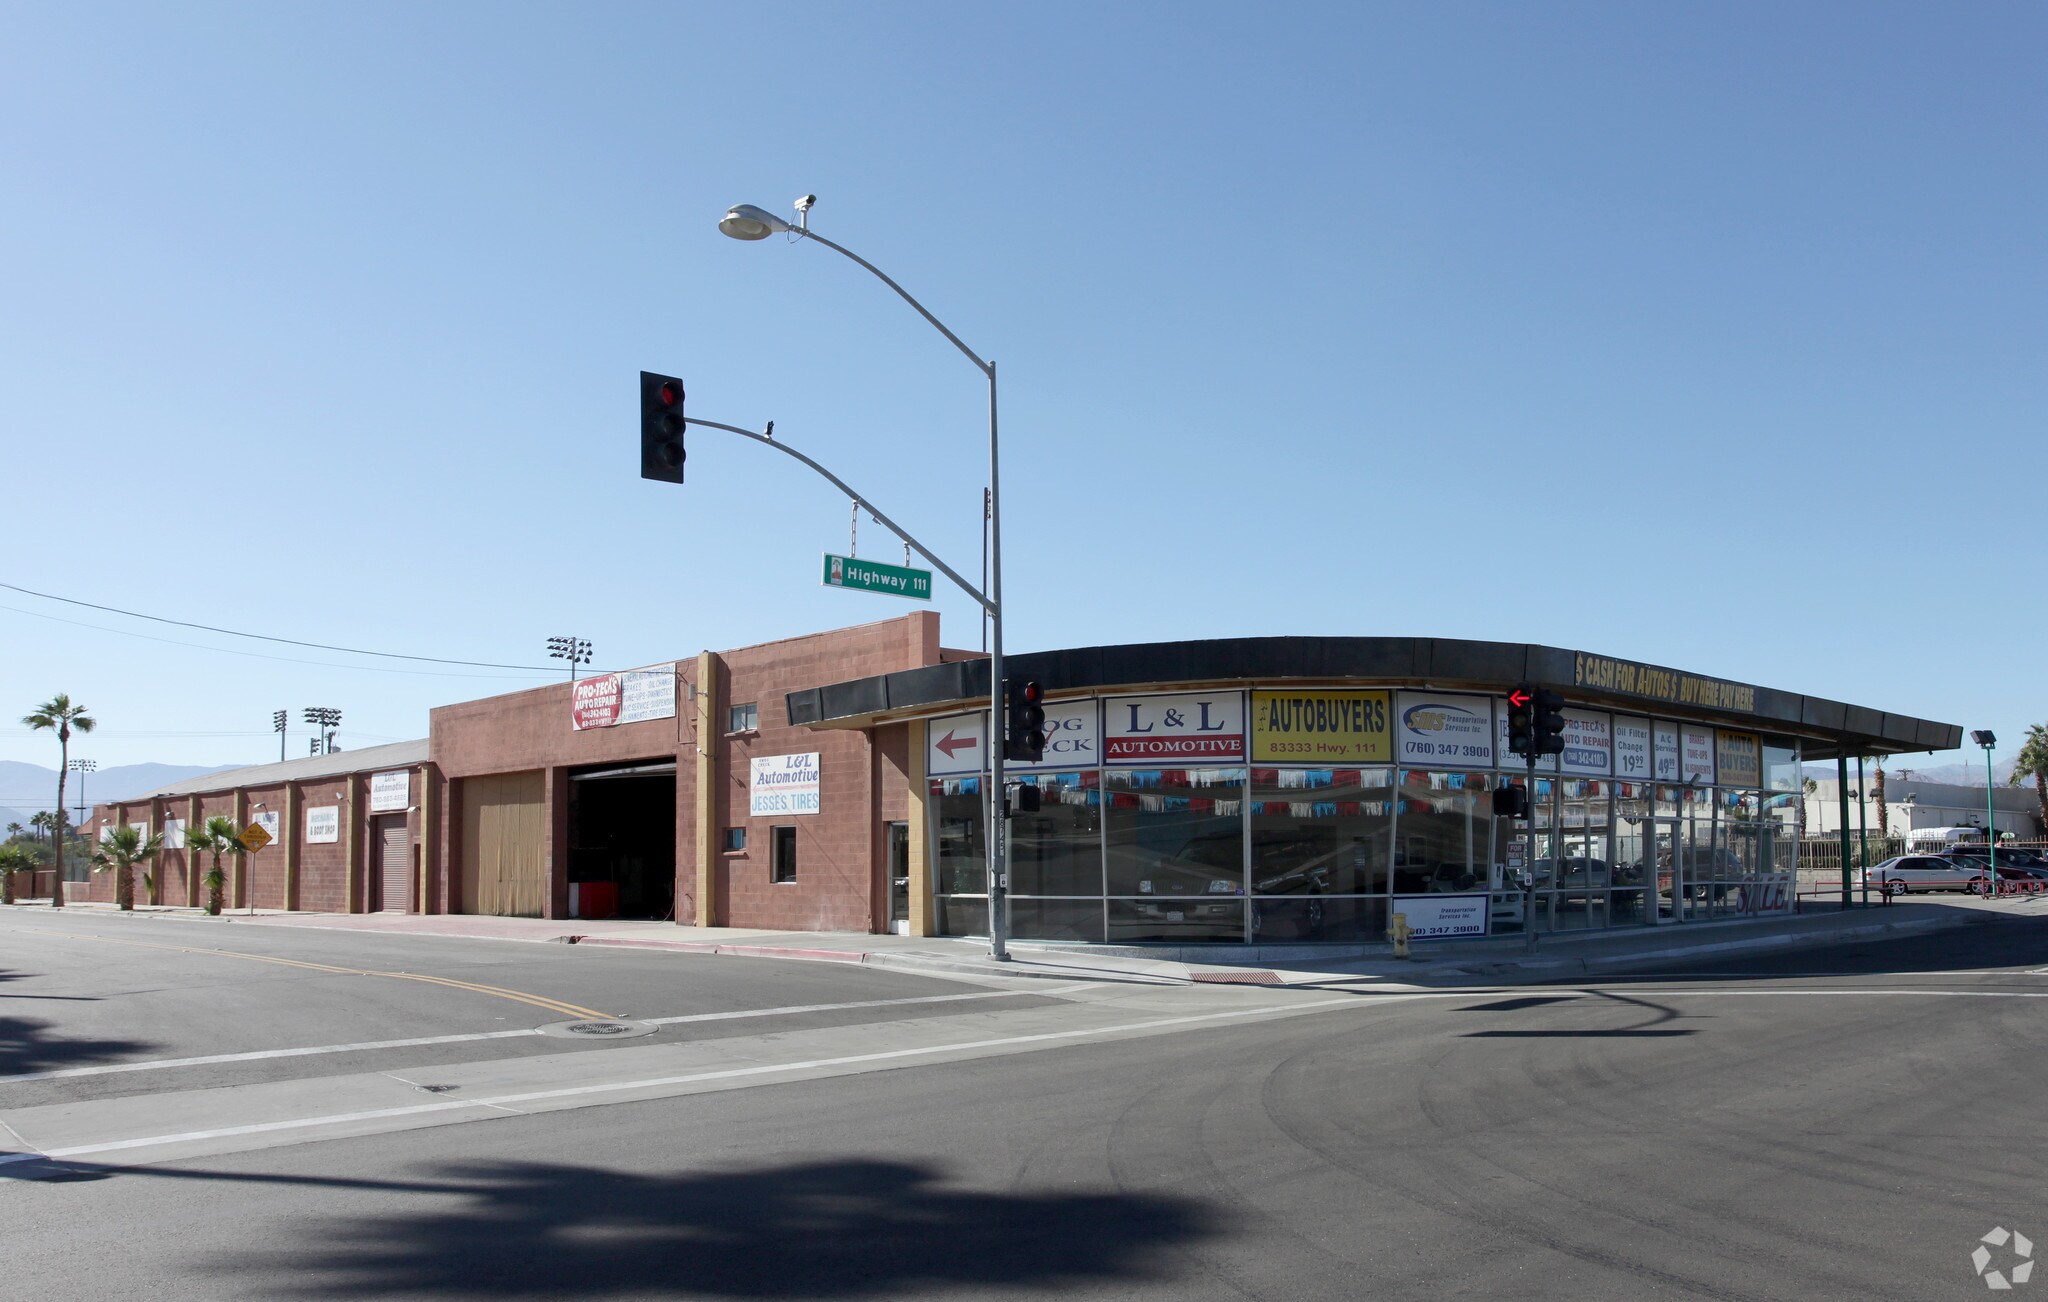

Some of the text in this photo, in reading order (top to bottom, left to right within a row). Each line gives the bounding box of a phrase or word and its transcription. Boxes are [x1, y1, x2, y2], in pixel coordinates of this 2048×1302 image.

[847, 566, 927, 591] Highway 111
[1585, 656, 1614, 689] CASH
[1615, 663, 1635, 692] FOR
[1637, 667, 1670, 698] AUTOS
[1680, 676, 1700, 703] BUY
[1699, 679, 1719, 707] HERE
[1719, 683, 1735, 709] PAY
[1734, 686, 1755, 712] HERE
[575, 695, 617, 711] AUTO REPAIR
[1126, 702, 1225, 733] L & L
[1268, 698, 1385, 733] AUTOBUYERS
[1446, 714, 1487, 725] Transportation
[1445, 723, 1470, 733] Services
[1616, 727, 1647, 738] Oil Filter
[1108, 739, 1241, 753] AUTOMOTIVE
[1583, 736, 1610, 748] REPAIR
[1617, 740, 1643, 753] Change
[1688, 734, 1705, 745] BRAKES
[1727, 735, 1754, 754] AUTO
[1270, 742, 1376, 755] 83333 Hwy. 111
[1405, 741, 1489, 758] (760) 347 3900
[1655, 744, 1678, 753] Service
[1687, 748, 1708, 760] TUNE-UPS
[1578, 750, 1604, 765] 342-4103
[1719, 752, 1757, 773] BUYERS
[757, 768, 818, 785] Automotive
[374, 781, 407, 792] Automotive
[791, 793, 819, 810] TIRES
[1508, 851, 1522, 859] RENT
[1736, 876, 1789, 913] SALE
[1429, 926, 1450, 934] 347
[1453, 925, 1480, 933] 3900
